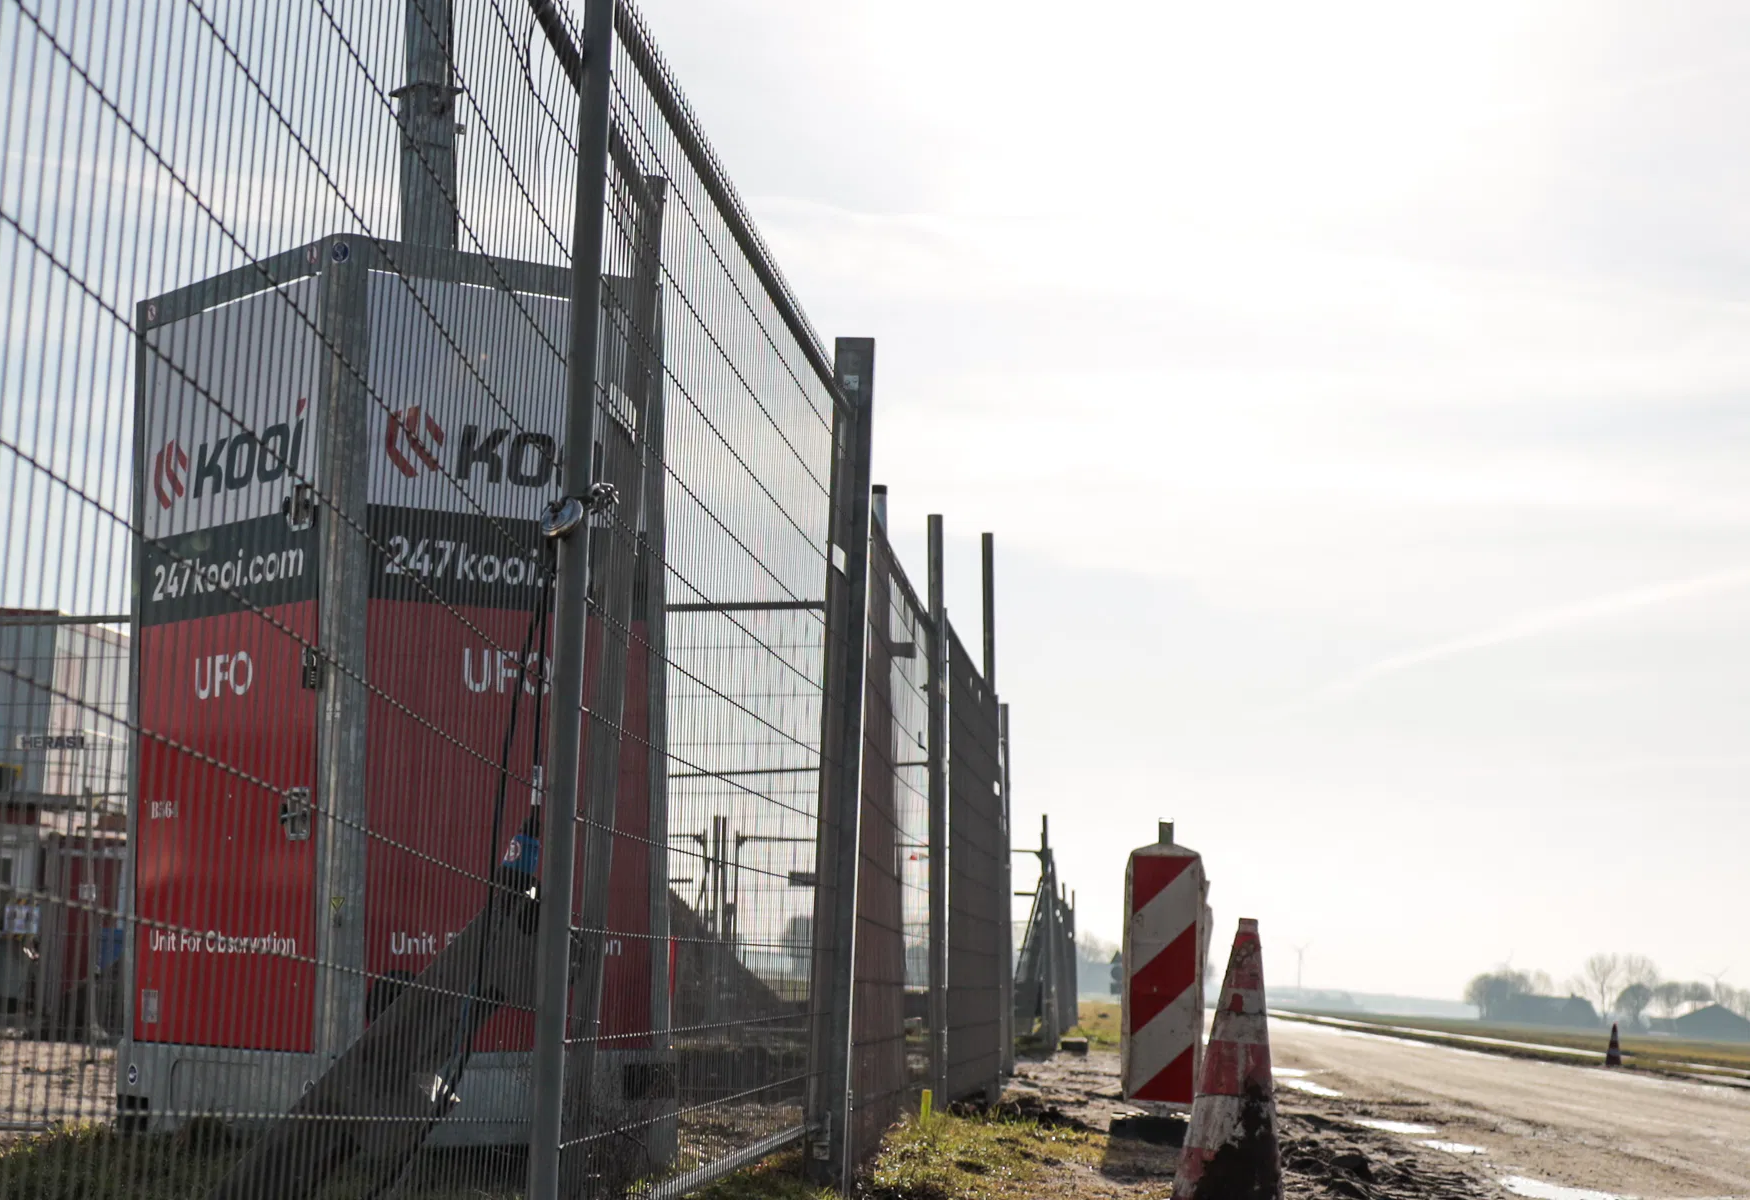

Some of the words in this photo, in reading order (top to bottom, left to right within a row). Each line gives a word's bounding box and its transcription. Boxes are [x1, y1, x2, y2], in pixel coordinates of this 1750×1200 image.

[152, 548, 304, 602] 247kooi.com
[195, 651, 253, 700] UFO
[464, 647, 551, 696] UFO
[150, 929, 177, 952] Unit
[180, 930, 202, 952] For
[206, 930, 296, 956] Observation
[391, 931, 437, 956] Unit
